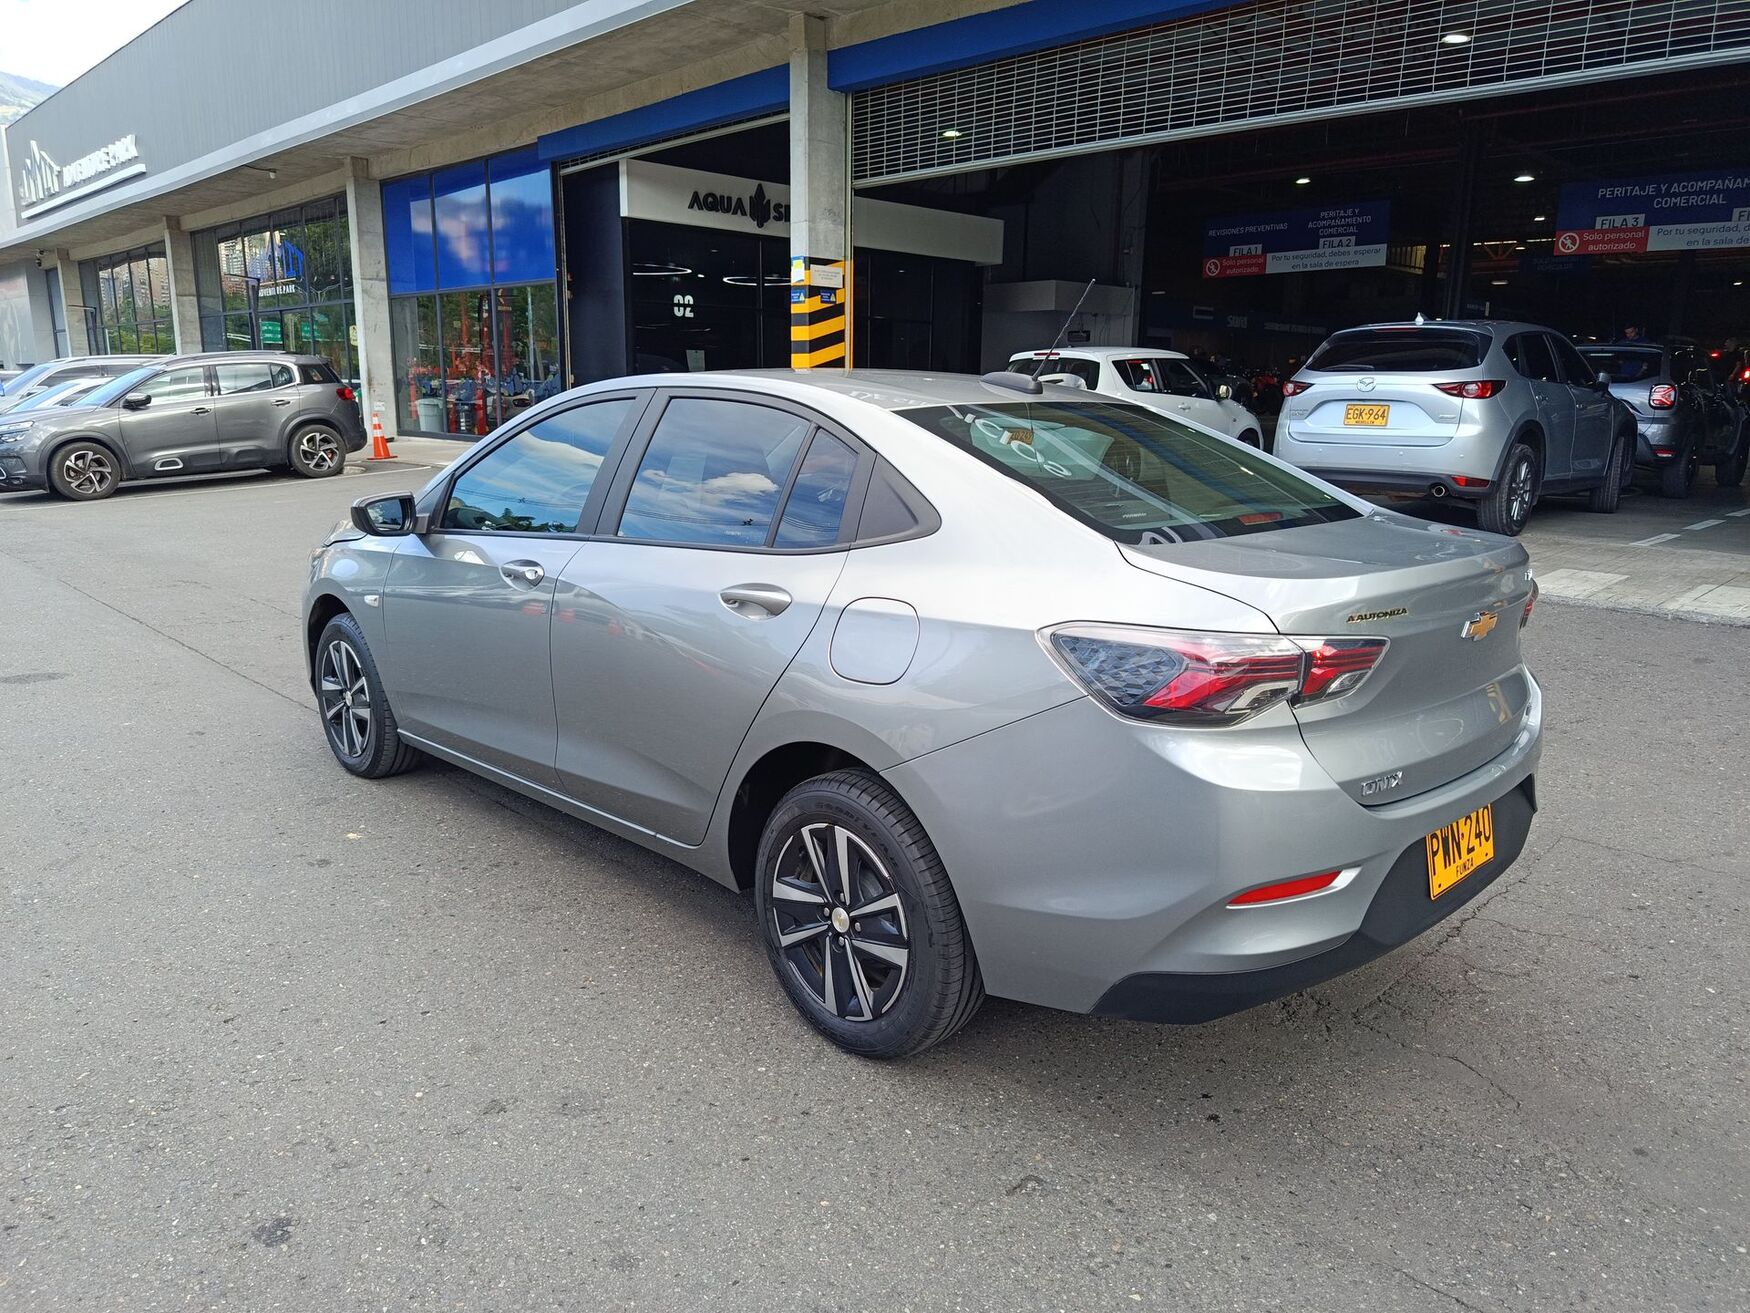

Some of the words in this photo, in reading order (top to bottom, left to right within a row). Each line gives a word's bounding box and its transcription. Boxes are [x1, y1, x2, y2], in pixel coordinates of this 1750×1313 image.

[1598, 184, 1657, 199] PERITAJE
[1660, 183, 1669, 194] Y
[688, 191, 748, 216] AQUA
[1654, 194, 1727, 208] COMERCIAL
[1320, 209, 1354, 218] PERITAJE
[1354, 208, 1360, 216] Y
[1307, 215, 1372, 229] ACOMPAÑAMIENTO
[1600, 217, 1628, 229] FILA
[1631, 216, 1640, 227] 3
[1207, 227, 1245, 237] REVISIONES
[1245, 222, 1289, 233] PREVENTIVAS
[1319, 226, 1359, 236] COMERCIAL
[1583, 232, 1603, 240] Solo
[1604, 230, 1645, 240] personal
[1656, 227, 1671, 236] Por
[1674, 227, 1685, 236] tu
[1685, 224, 1741, 237] seguridad,
[1322, 239, 1344, 249] FILA
[1345, 238, 1352, 248] 2
[1588, 241, 1636, 251] autorizado
[1686, 239, 1697, 247] en
[1701, 237, 1711, 246] la
[1712, 236, 1733, 246] sala
[1736, 235, 1750, 245] de
[1233, 248, 1254, 256] FILA
[1254, 246, 1259, 255] 1
[1271, 253, 1282, 262] Por
[1283, 253, 1291, 261] tu
[1328, 249, 1351, 258] debes
[1354, 247, 1382, 258] esperar
[1222, 258, 1236, 267] Solo
[1236, 257, 1264, 267] personal
[1302, 261, 1309, 269] la
[1309, 260, 1324, 269] sala
[1324, 259, 1334, 268] de
[1334, 259, 1360, 269] espera
[1226, 266, 1259, 274] autorizado
[1361, 771, 1403, 797] ONIX
[1456, 857, 1474, 877] FUNZA
